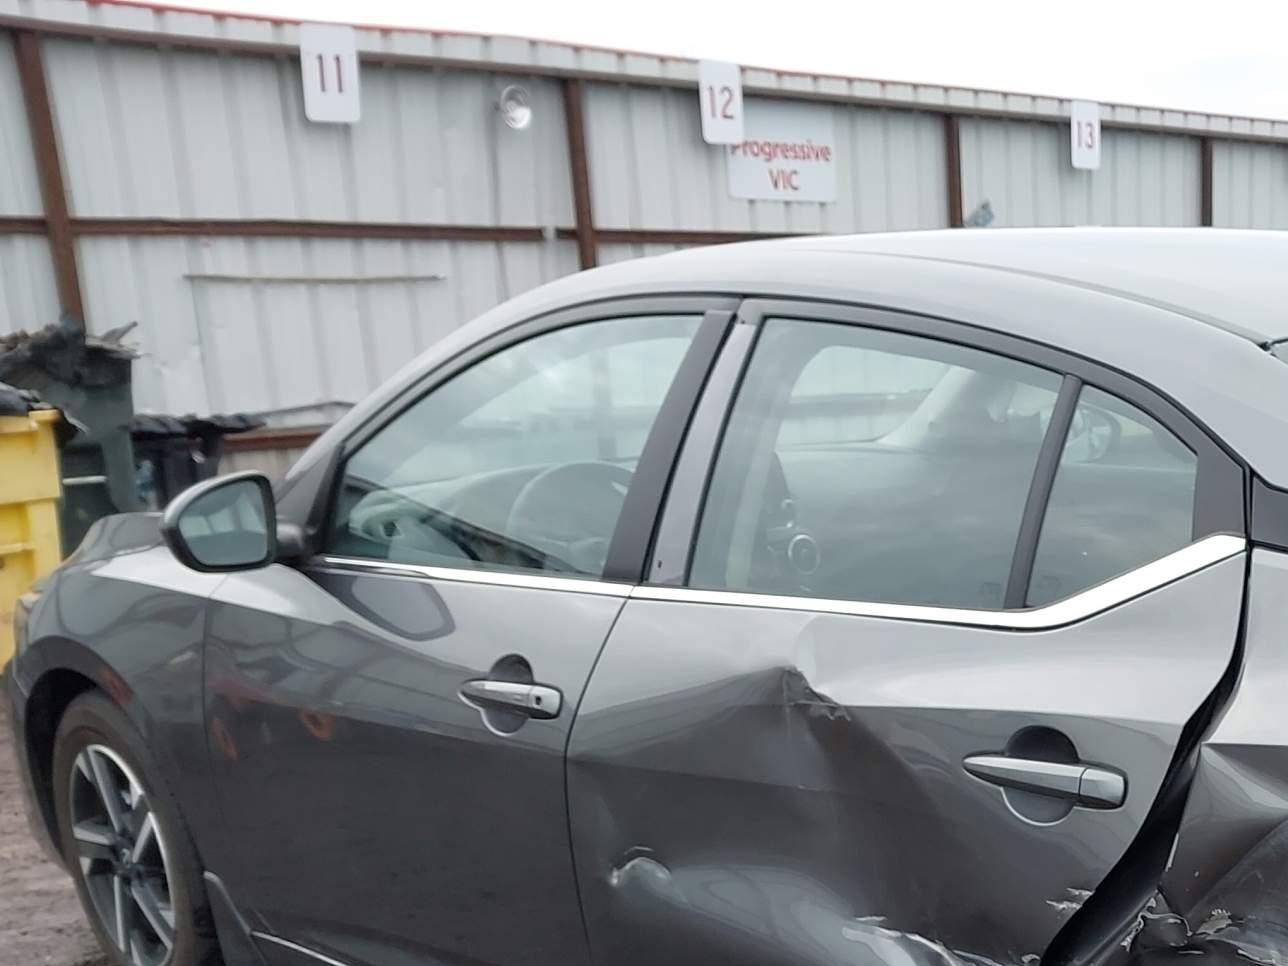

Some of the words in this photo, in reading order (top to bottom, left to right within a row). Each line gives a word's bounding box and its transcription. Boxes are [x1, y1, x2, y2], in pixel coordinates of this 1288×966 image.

[316, 53, 344, 93] 11
[707, 85, 735, 119] 12
[1076, 121, 1095, 149] 13
[768, 169, 799, 191] VIC
